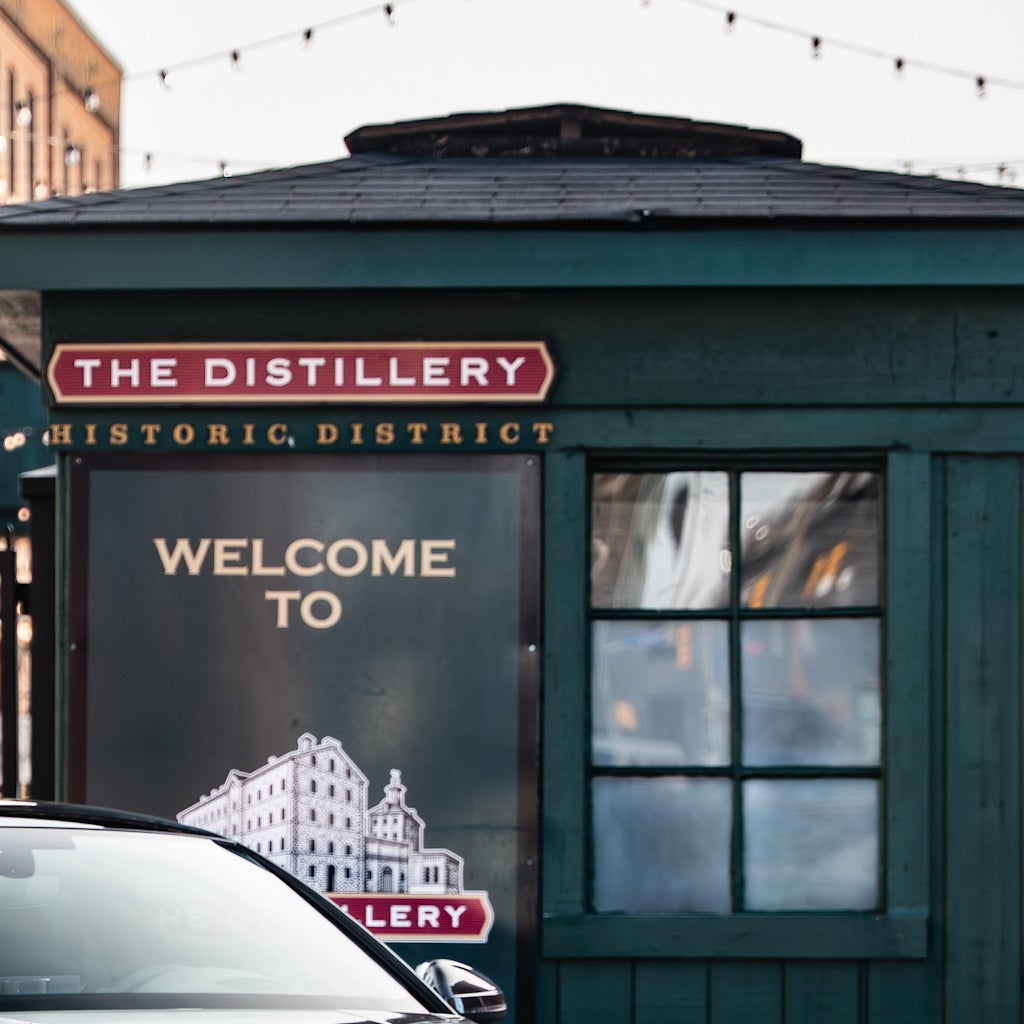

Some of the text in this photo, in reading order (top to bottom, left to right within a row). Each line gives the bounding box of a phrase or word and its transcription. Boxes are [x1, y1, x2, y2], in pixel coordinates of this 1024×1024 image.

[74, 356, 526, 388] THE DISTILLERY
[51, 422, 554, 446] HISTORIC DISTRICT
[154, 537, 456, 578] WELCOME
[264, 590, 343, 629] TO
